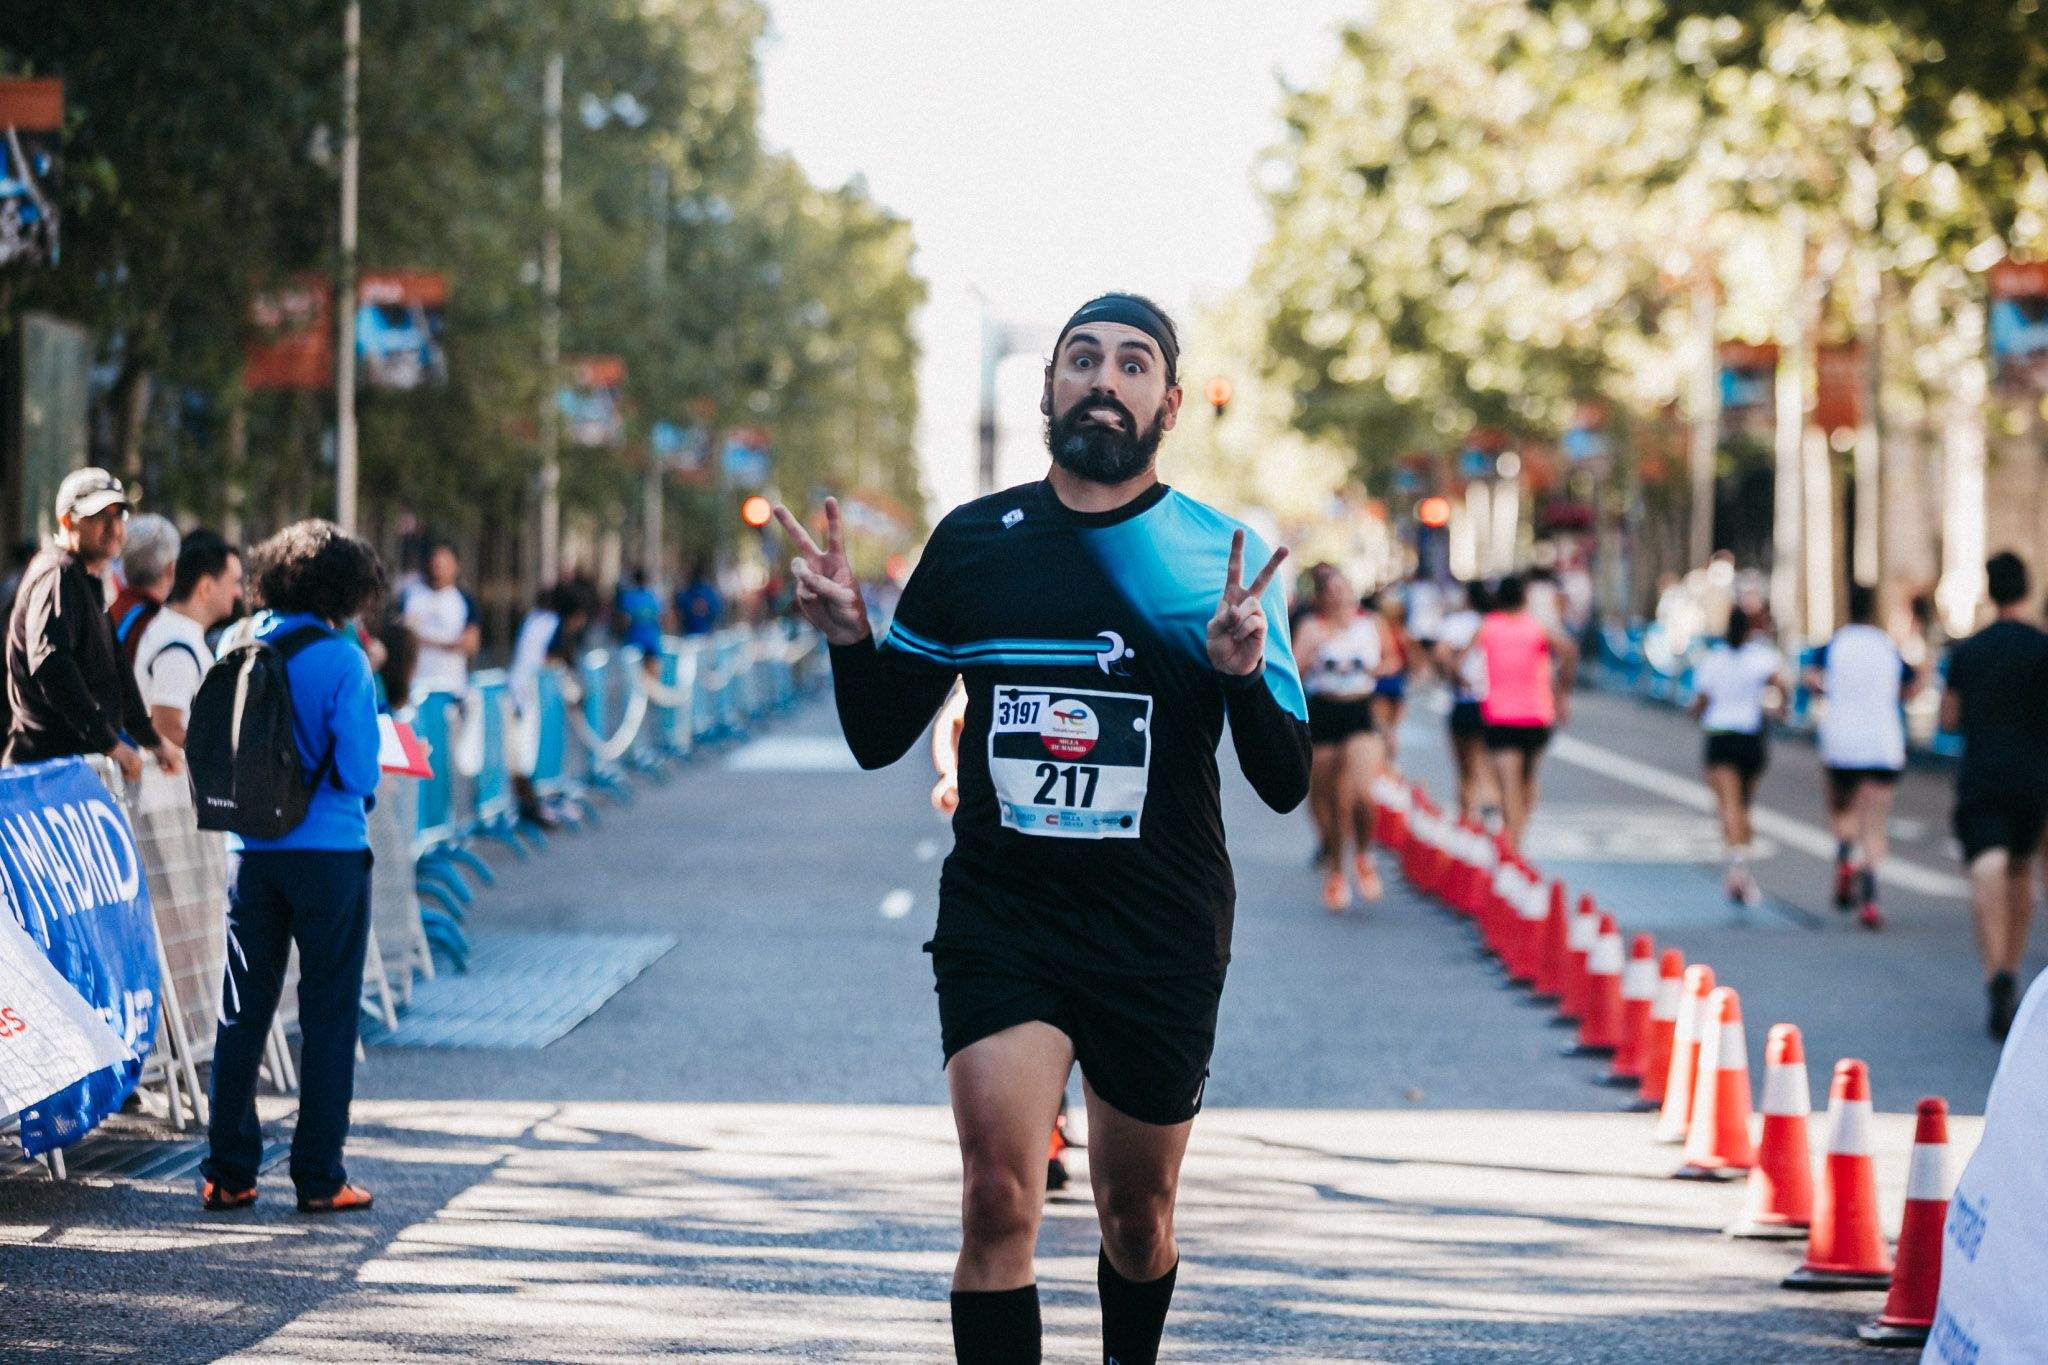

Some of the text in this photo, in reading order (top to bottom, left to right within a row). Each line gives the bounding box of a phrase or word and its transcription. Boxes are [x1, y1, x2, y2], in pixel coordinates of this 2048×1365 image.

[999, 701, 1040, 726] 3197
[1061, 745, 1087, 753] MADRID
[1033, 762, 1100, 809] 217
[4, 799, 139, 921] MADRID
